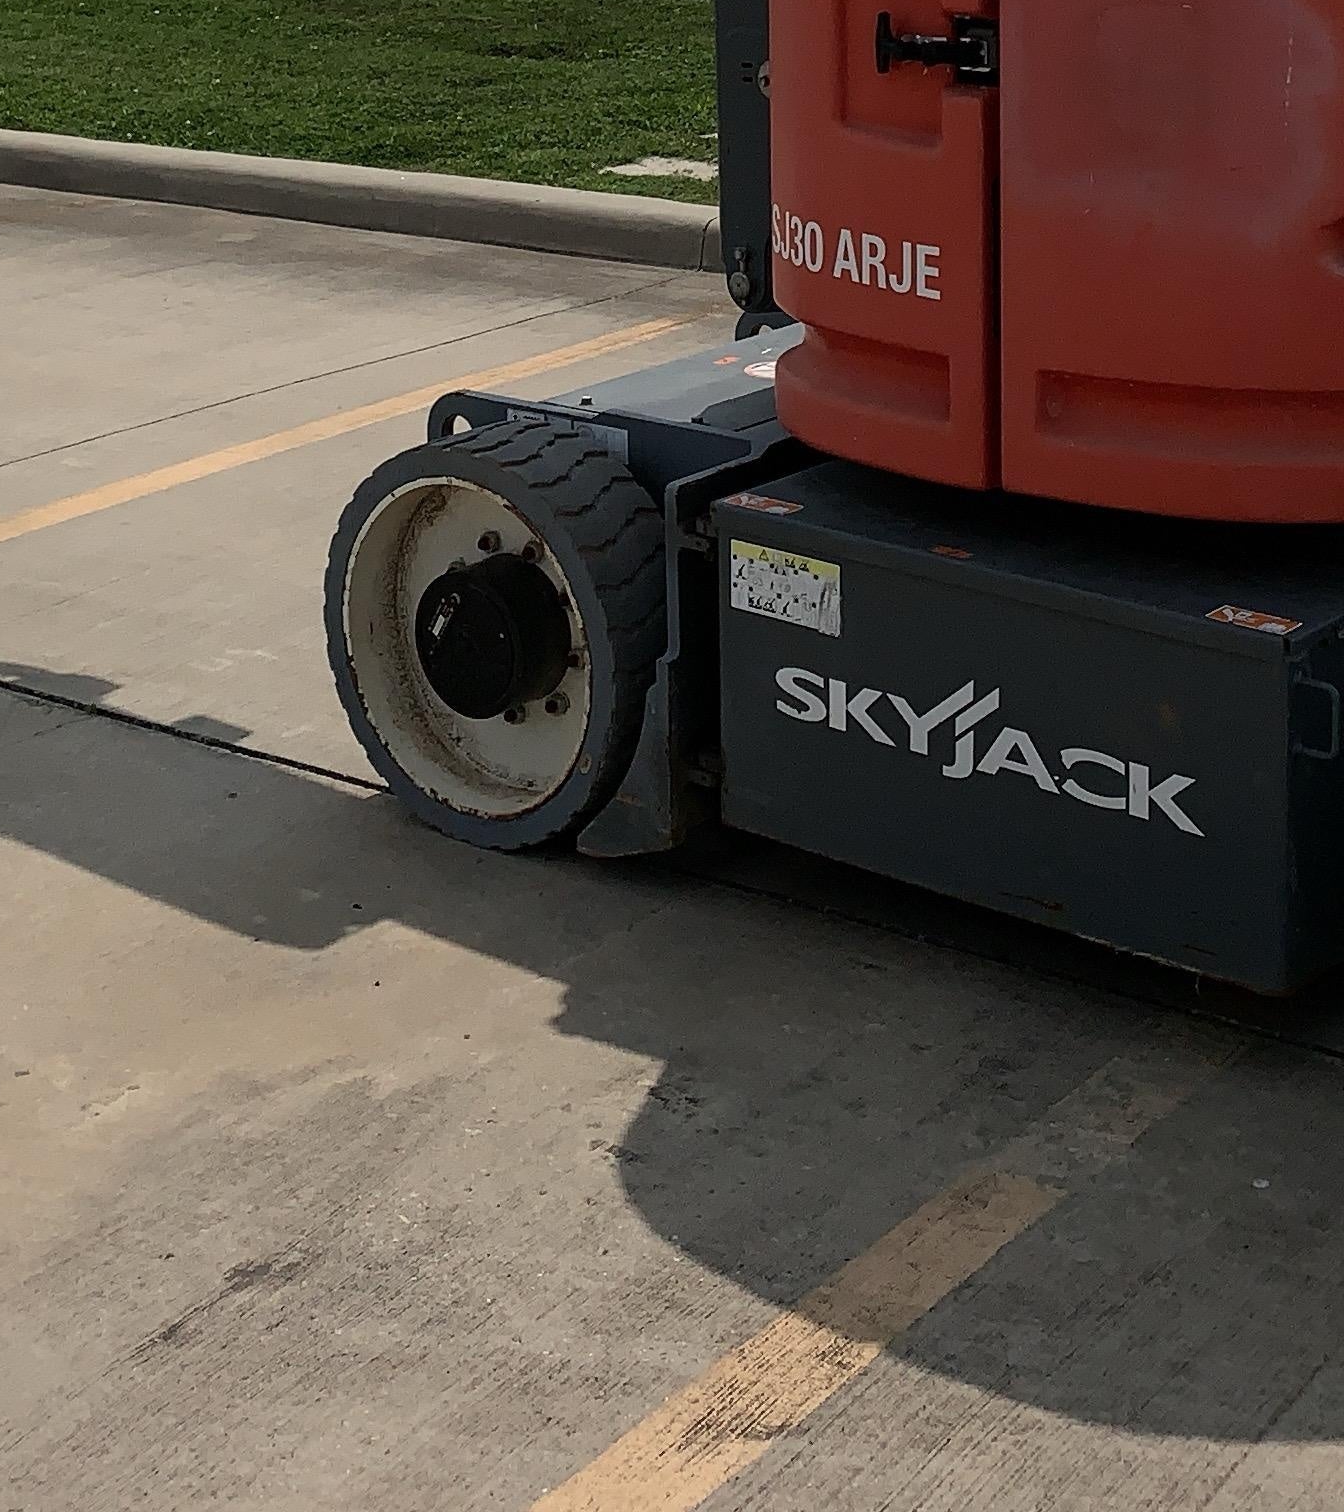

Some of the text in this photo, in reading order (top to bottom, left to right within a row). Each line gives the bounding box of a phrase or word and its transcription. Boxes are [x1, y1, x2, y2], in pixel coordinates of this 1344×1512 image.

[772, 203, 941, 301] SJ30 ARJE
[775, 667, 1205, 837] SKYJACK
